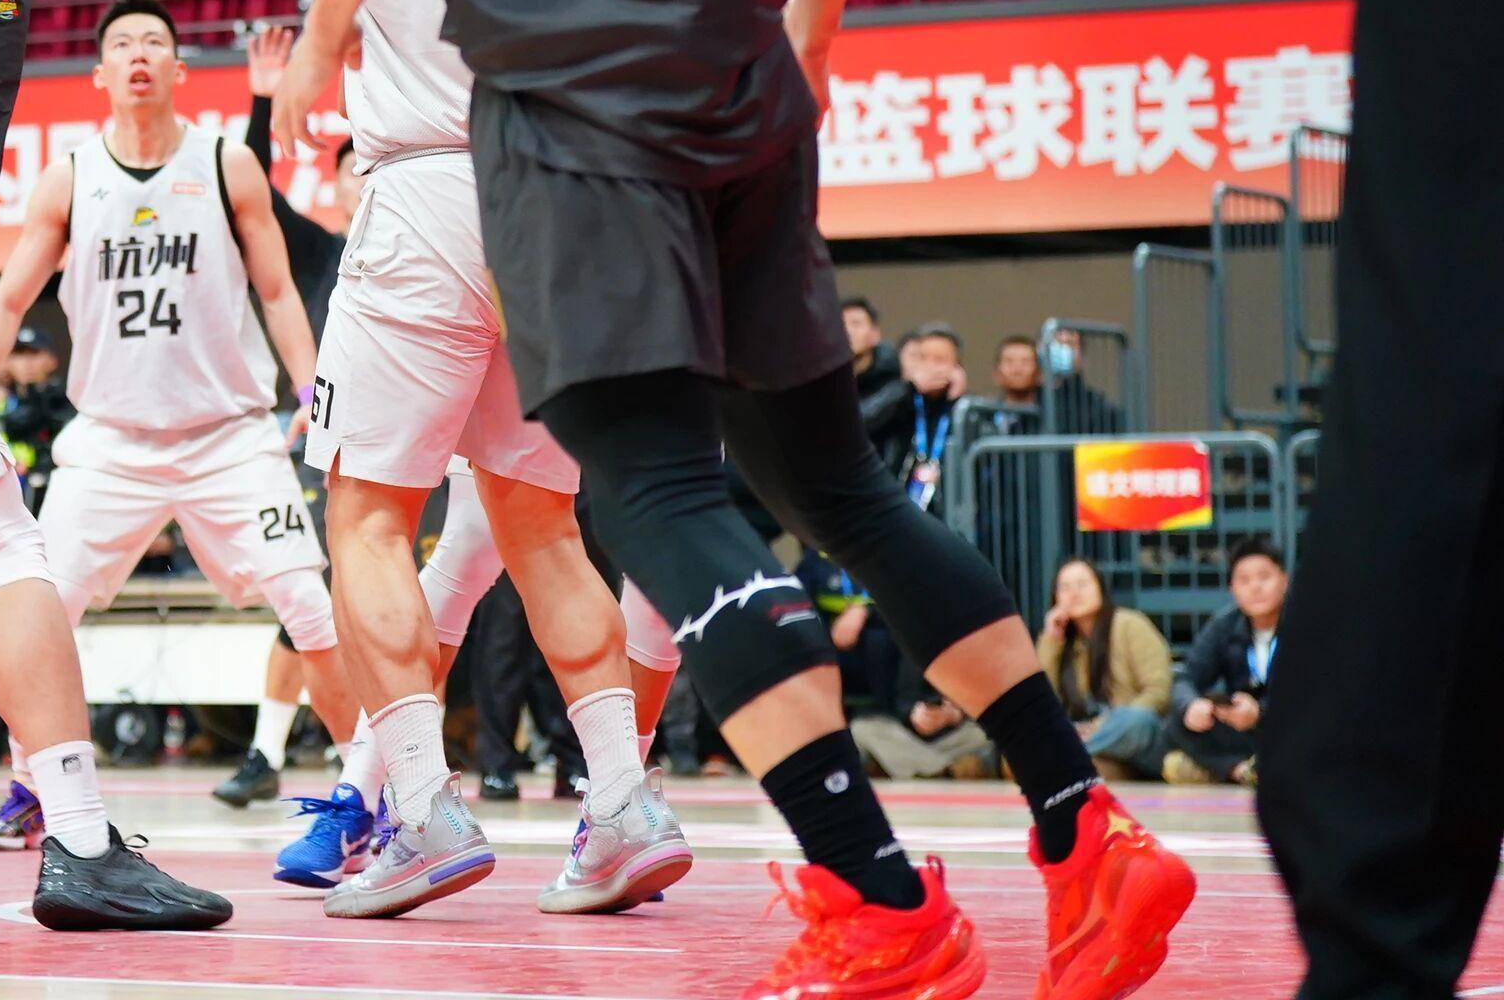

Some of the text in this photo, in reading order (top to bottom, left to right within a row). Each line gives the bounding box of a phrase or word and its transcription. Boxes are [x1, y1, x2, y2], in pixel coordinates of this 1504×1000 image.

[818, 45, 1353, 187] 篮球联赛
[98, 233, 198, 283] 杭州
[117, 288, 182, 339] 24
[258, 504, 306, 542] 24
